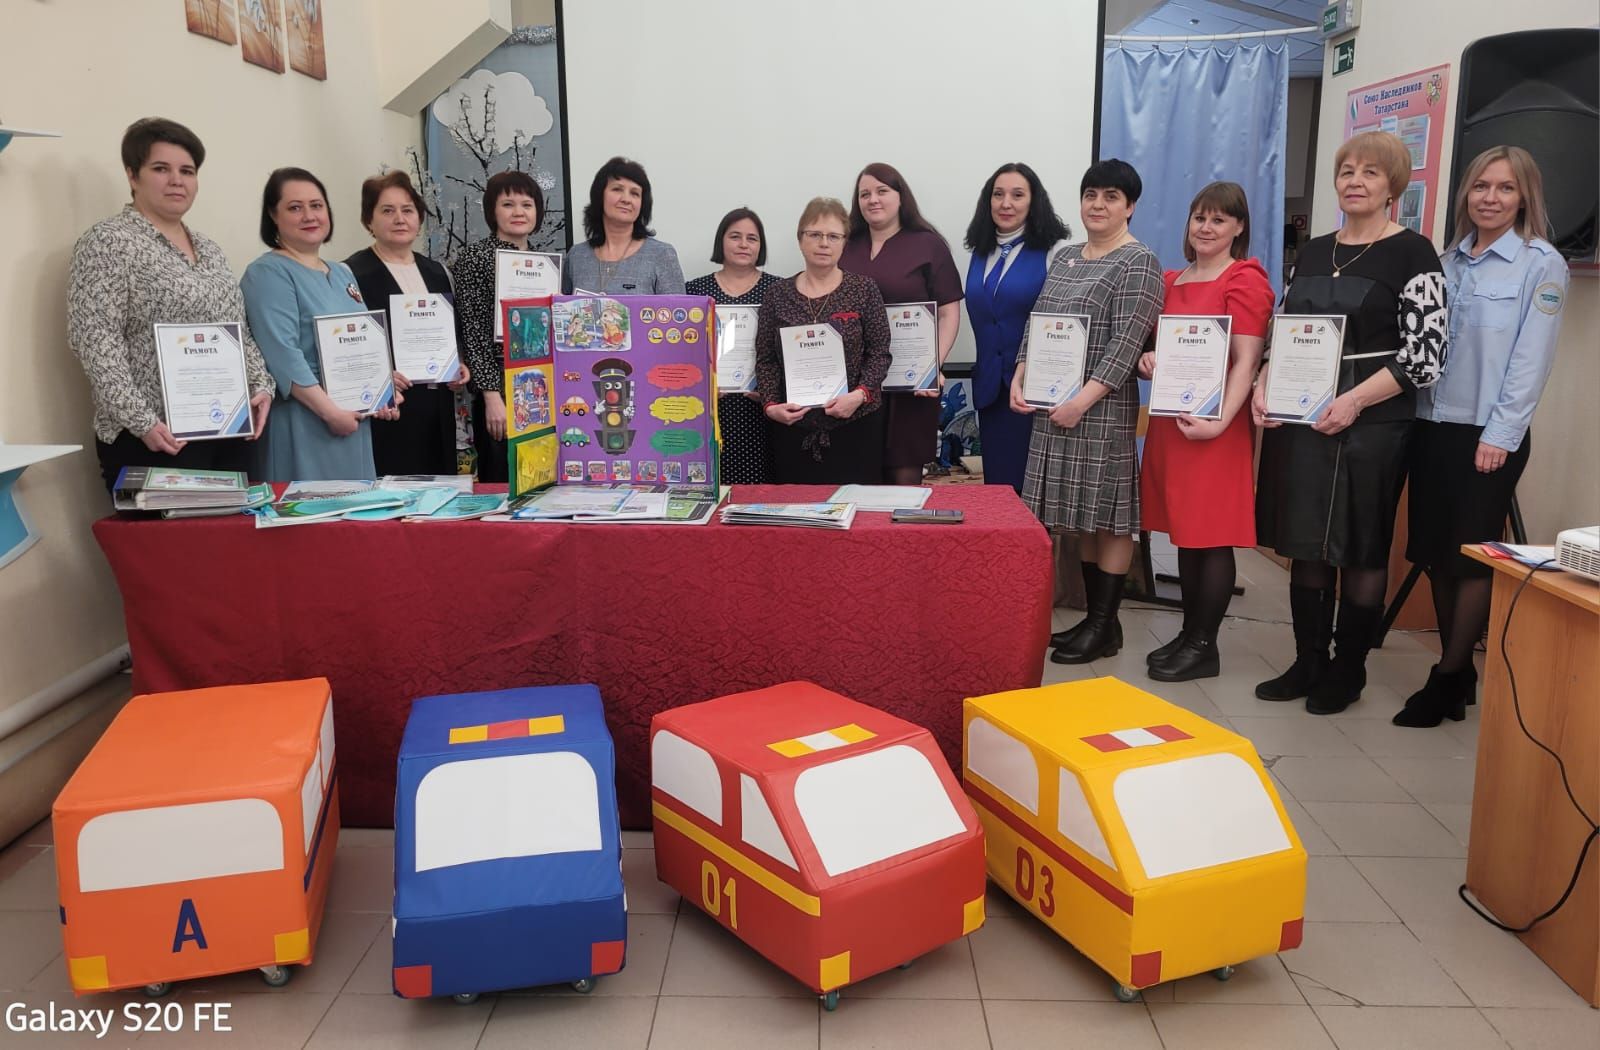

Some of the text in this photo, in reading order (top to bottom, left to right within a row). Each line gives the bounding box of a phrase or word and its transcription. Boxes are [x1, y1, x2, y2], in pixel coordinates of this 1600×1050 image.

[1363, 82, 1423, 105] Союз Наследников
[1374, 99, 1409, 115] Татарстана
[701, 859, 738, 931] 01
[1016, 845, 1056, 918] 03
